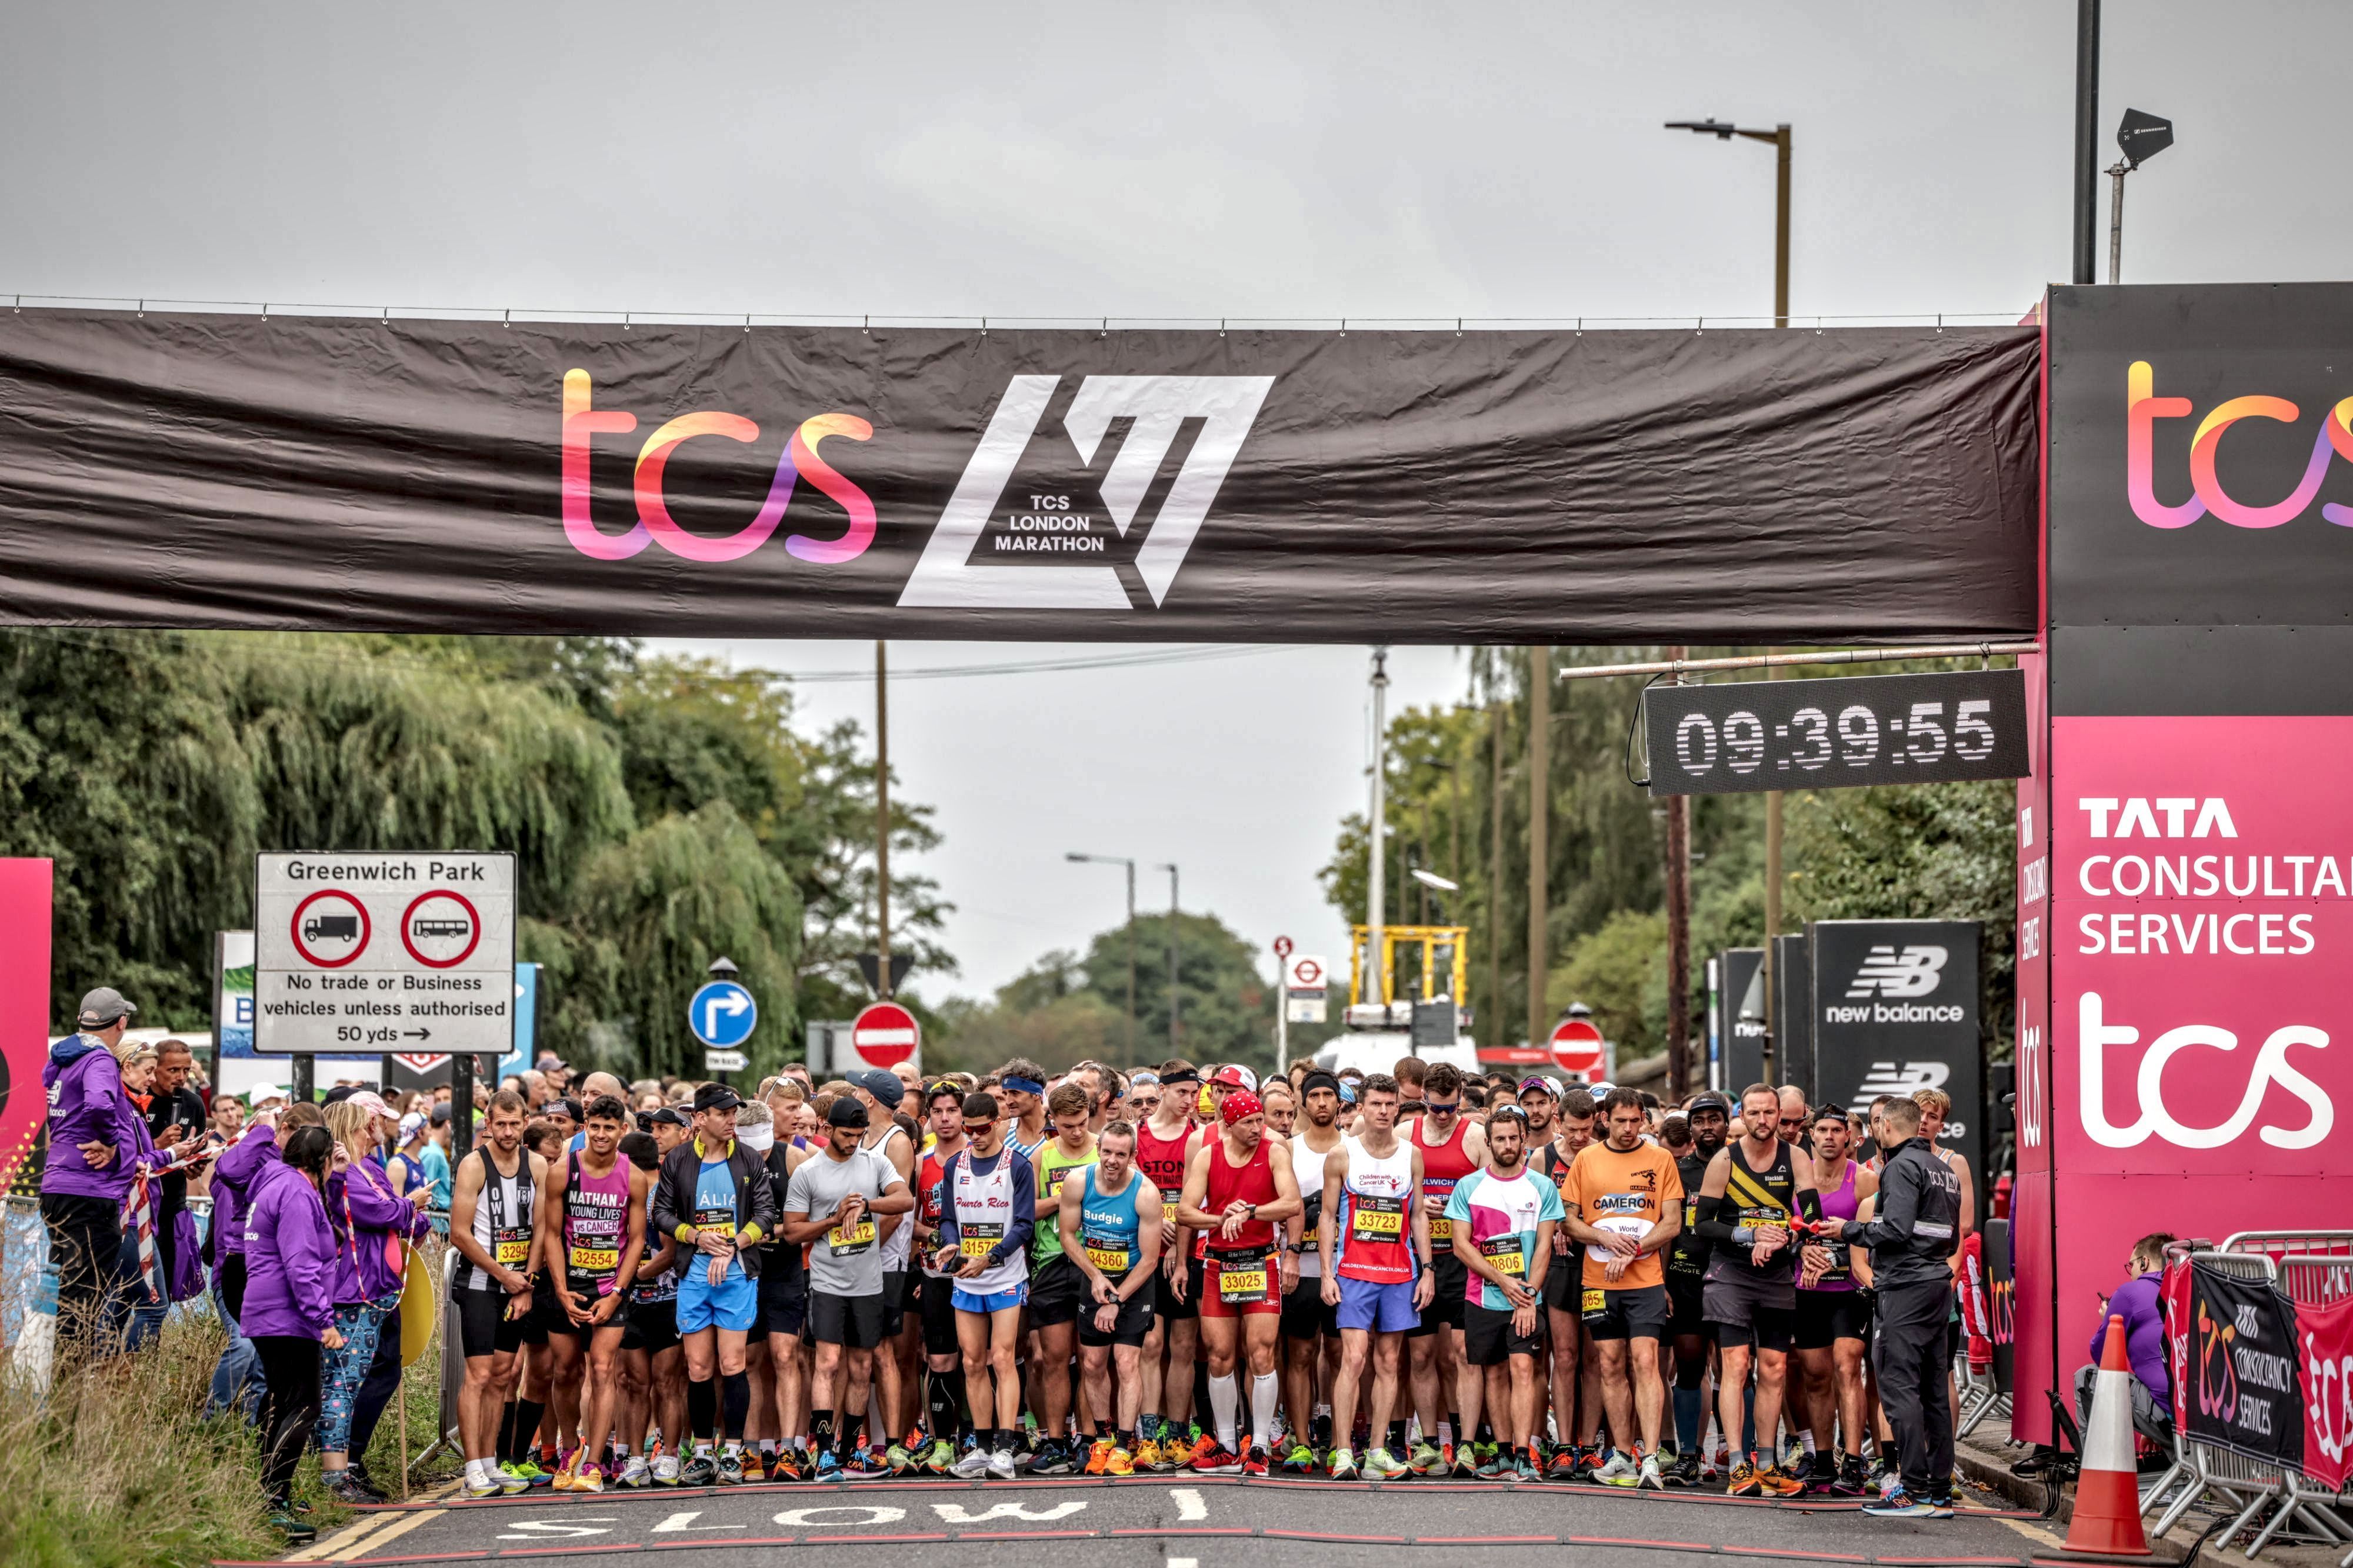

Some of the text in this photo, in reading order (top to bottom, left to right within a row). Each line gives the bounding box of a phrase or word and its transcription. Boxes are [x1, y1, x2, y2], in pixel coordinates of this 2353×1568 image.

[562, 368, 876, 563] tcs
[1030, 495, 1070, 511] TCS
[1009, 515, 1090, 532] LONDON
[995, 535, 1105, 552] MARATHON
[1676, 699, 1995, 776] 09:39:55
[2079, 798, 2238, 838] TATA
[2022, 806, 2033, 848] TATA
[287, 861, 485, 880] Greenwich Park
[2079, 855, 2353, 897] CONSULTA
[2079, 913, 2315, 955] SERVICES
[287, 975, 482, 990] No trade or Business
[264, 1001, 505, 1016] vehicles unless authorised
[1826, 1003, 1964, 1023] new balance
[337, 1026, 398, 1044] 50 yds
[2022, 997, 2041, 1147] tcs
[2079, 992, 2334, 1149] tcs
[1631, 1169, 1654, 1177] DEVERON
[568, 1190, 628, 1207] NATHAN J
[696, 1190, 736, 1206] ÁLIA
[955, 1196, 984, 1208] Puerto
[987, 1197, 1010, 1209] Rico
[1359, 1197, 1377, 1210] tcs
[1593, 1197, 1655, 1210] CAMERON
[490, 1187, 502, 1242] OWL
[569, 1205, 622, 1220] YOUNG LIVES
[1084, 1209, 1123, 1225] Budgie
[575, 1220, 618, 1233] vs CANCER
[1359, 1213, 1397, 1229] 33723
[1429, 1222, 1449, 1235] 933
[1619, 1225, 1638, 1233] World
[500, 1230, 517, 1241] tcs
[834, 1225, 871, 1242] 312
[964, 1225, 978, 1236] tcs
[574, 1237, 592, 1248] tcs
[1482, 1243, 1497, 1255] tcs
[502, 1245, 529, 1259] 3294
[575, 1250, 612, 1266] 32554
[1089, 1250, 1122, 1267] 34360
[1225, 1274, 1261, 1289] 33025
[2235, 1346, 2292, 1394] CONSULTANCY
[2238, 1393, 2272, 1436] SERVICES
[495, 1501, 1089, 1539] SLOW
